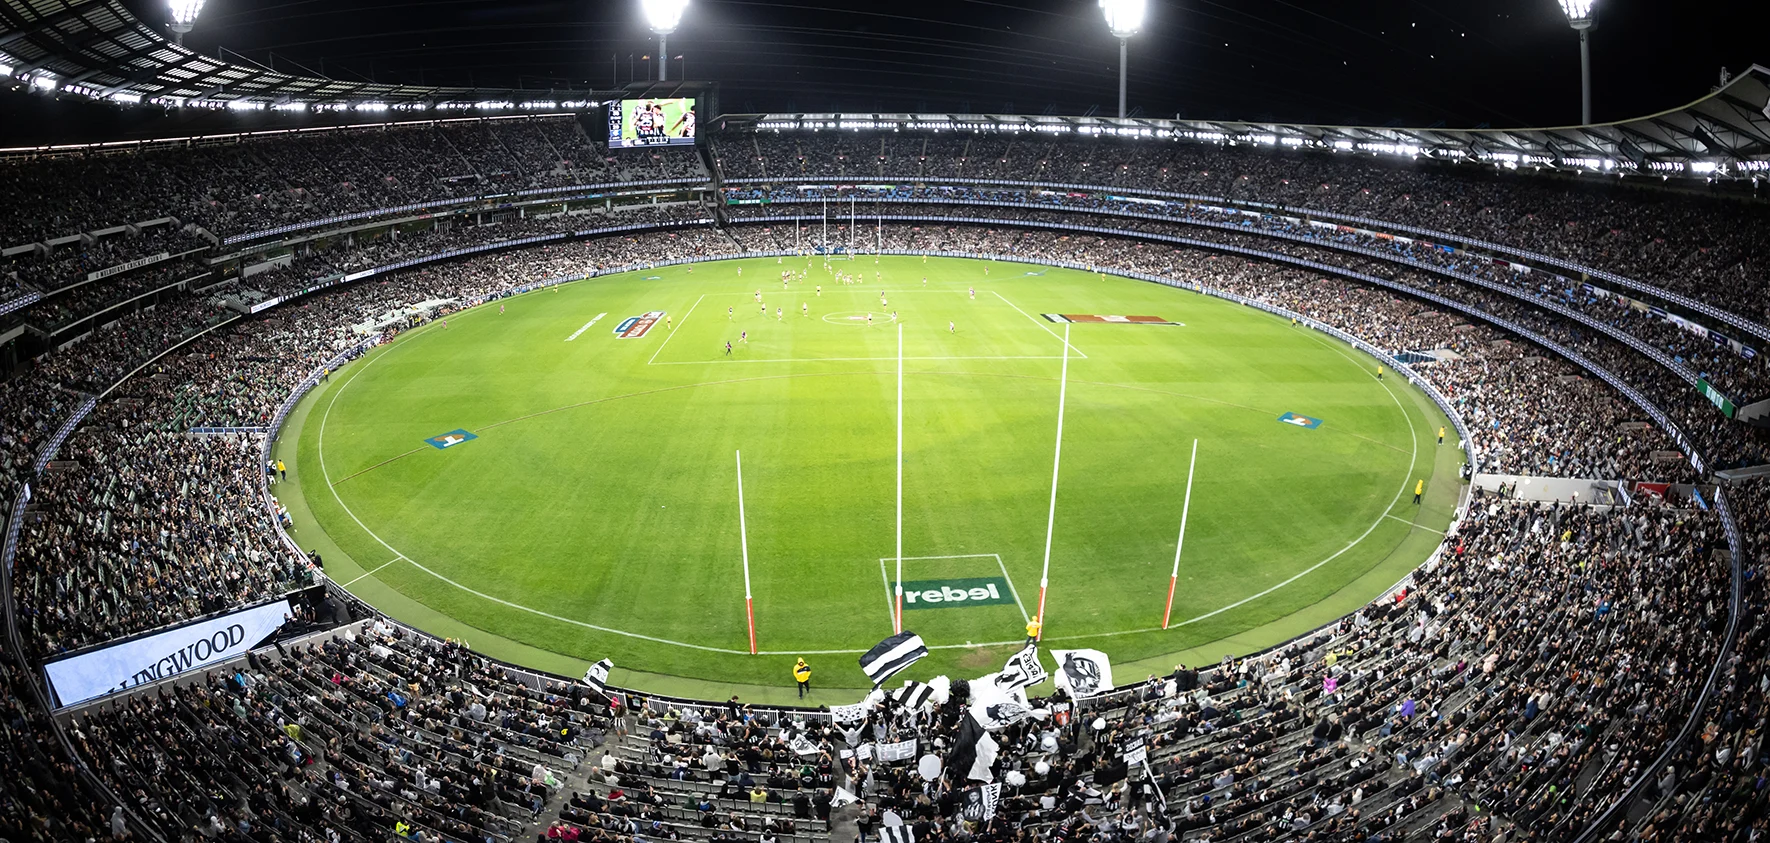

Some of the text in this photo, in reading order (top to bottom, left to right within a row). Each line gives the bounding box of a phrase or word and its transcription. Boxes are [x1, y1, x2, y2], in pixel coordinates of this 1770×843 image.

[100, 255, 159, 277] MELBOURNE CRICKET CLUB
[904, 583, 1000, 604] rebel
[107, 623, 245, 693] INGWOOD
